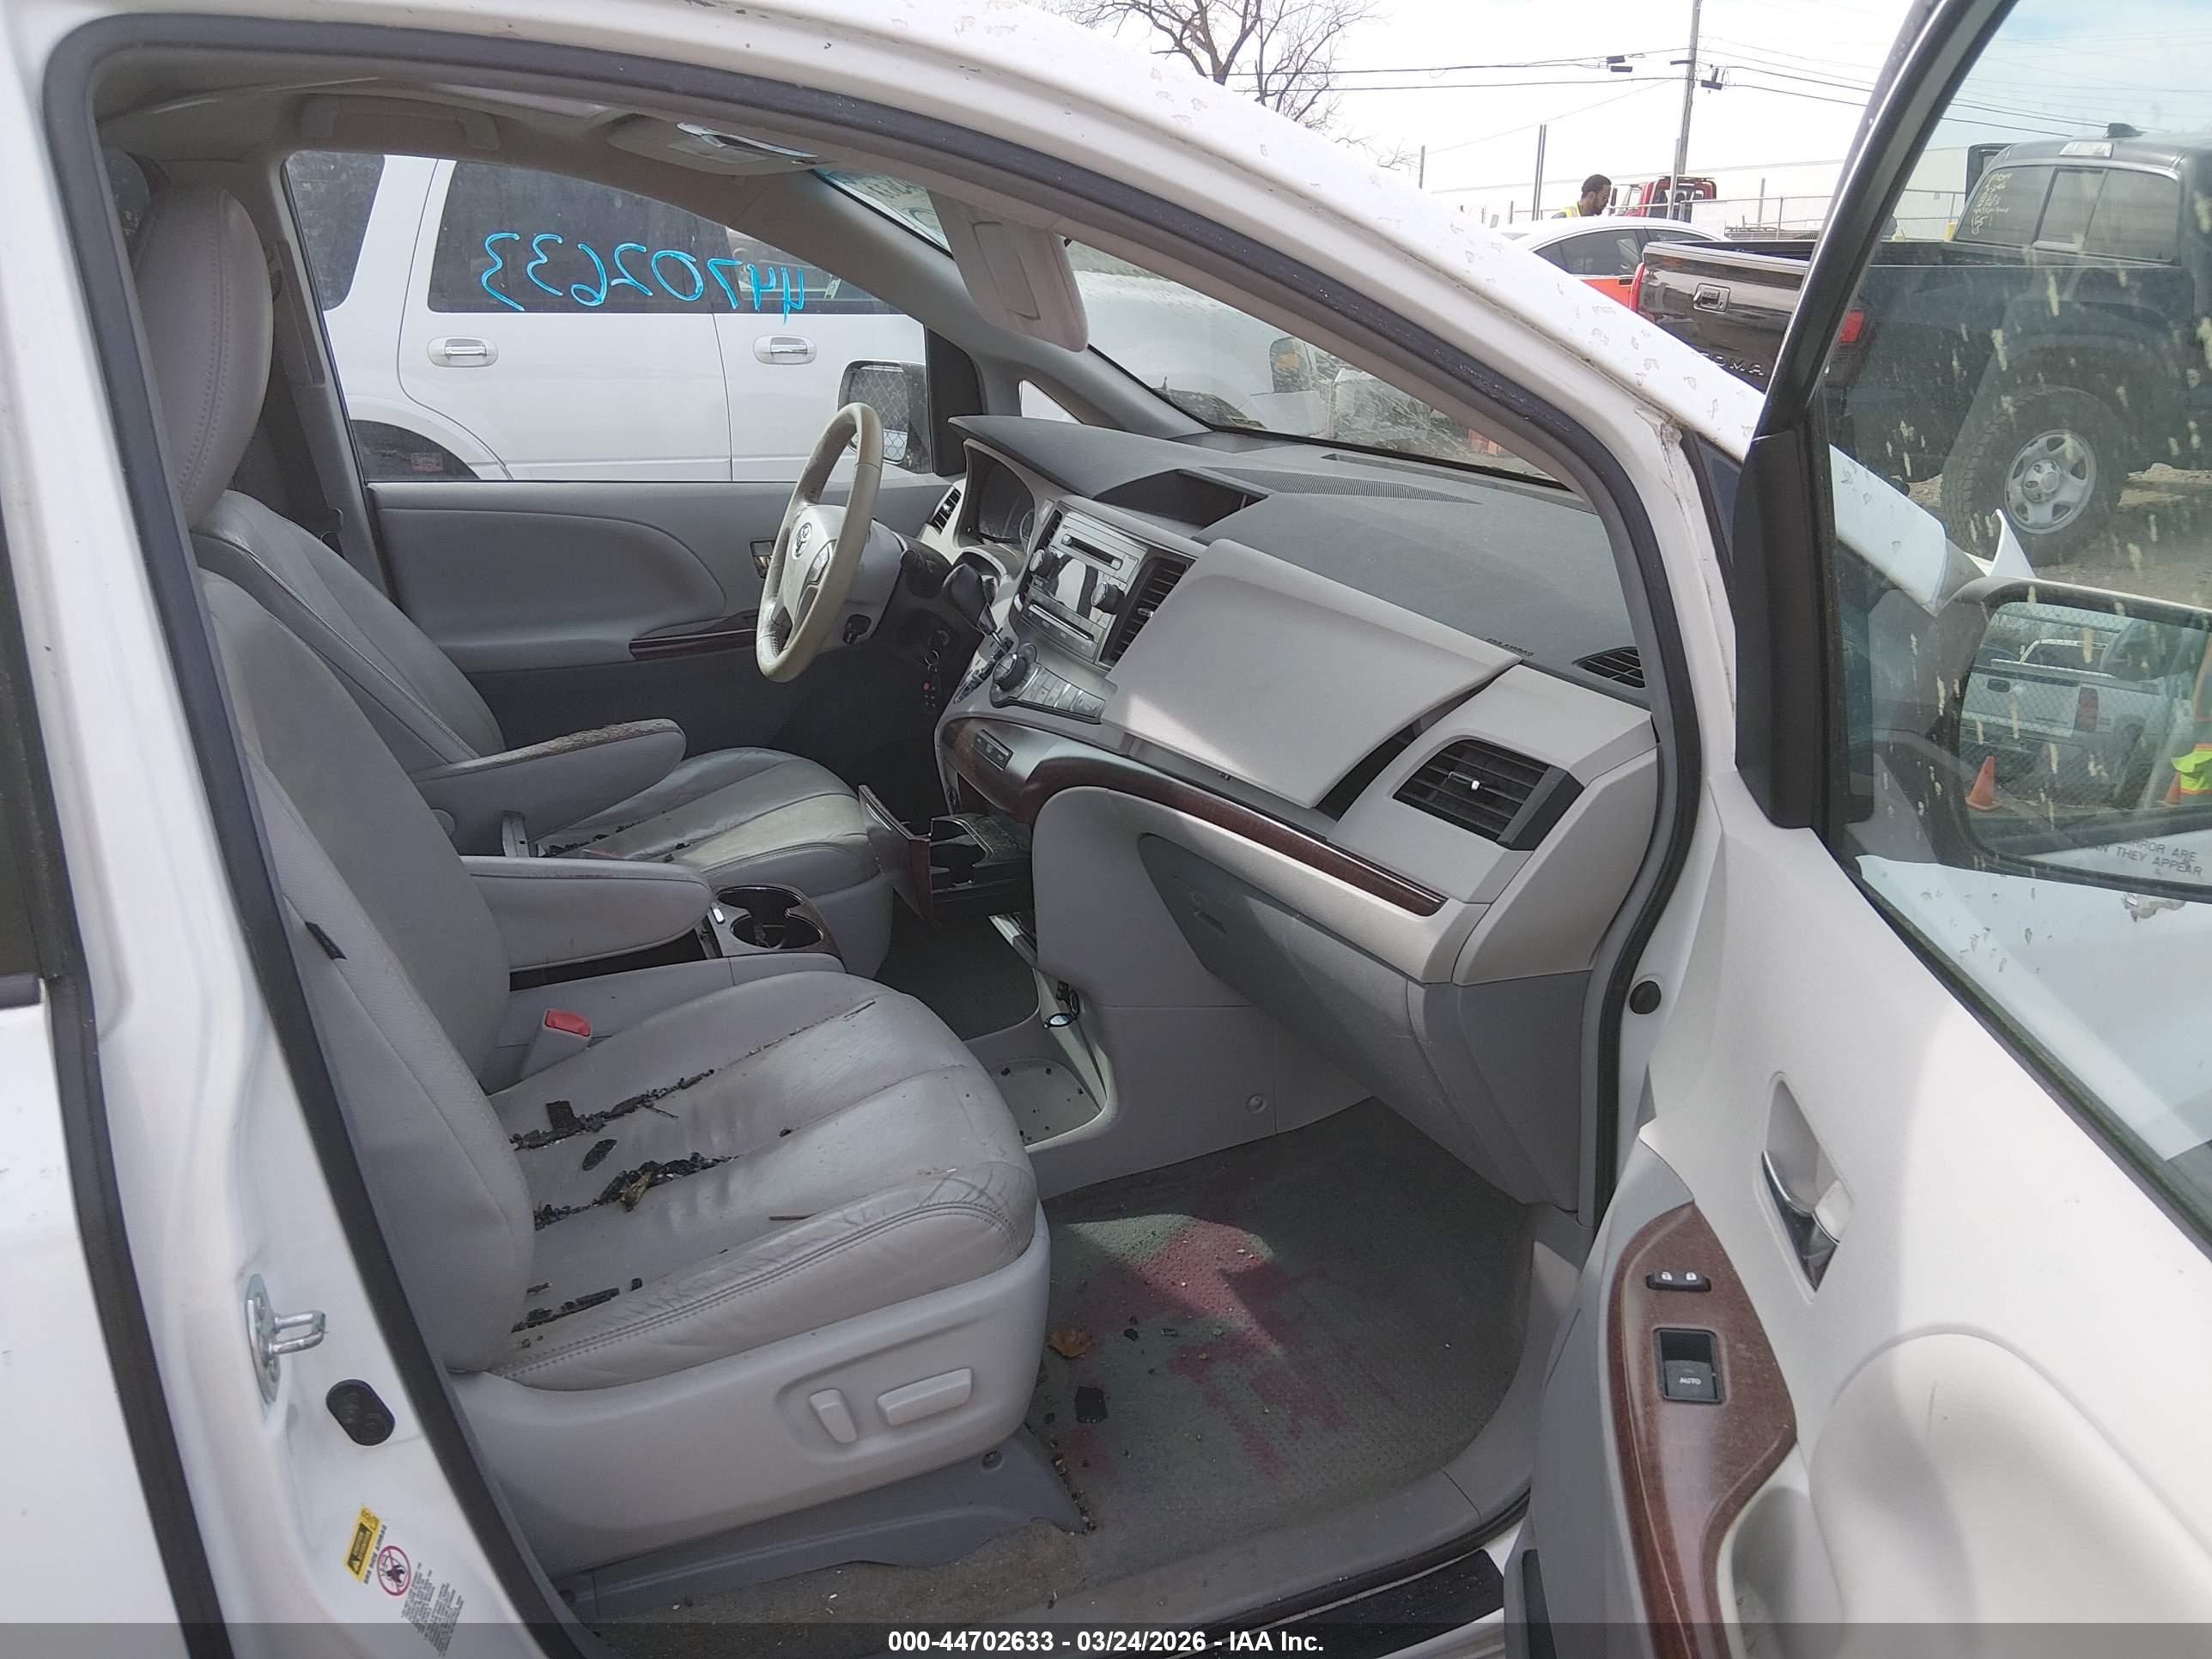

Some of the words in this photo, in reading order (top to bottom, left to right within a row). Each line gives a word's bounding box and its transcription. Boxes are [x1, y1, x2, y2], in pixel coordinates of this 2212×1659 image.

[2116, 846, 2148, 862] THEY
[2151, 856, 2203, 876] APPEAR
[2171, 848, 2197, 862] ARE
[1679, 1376, 1702, 1385] AUTO
